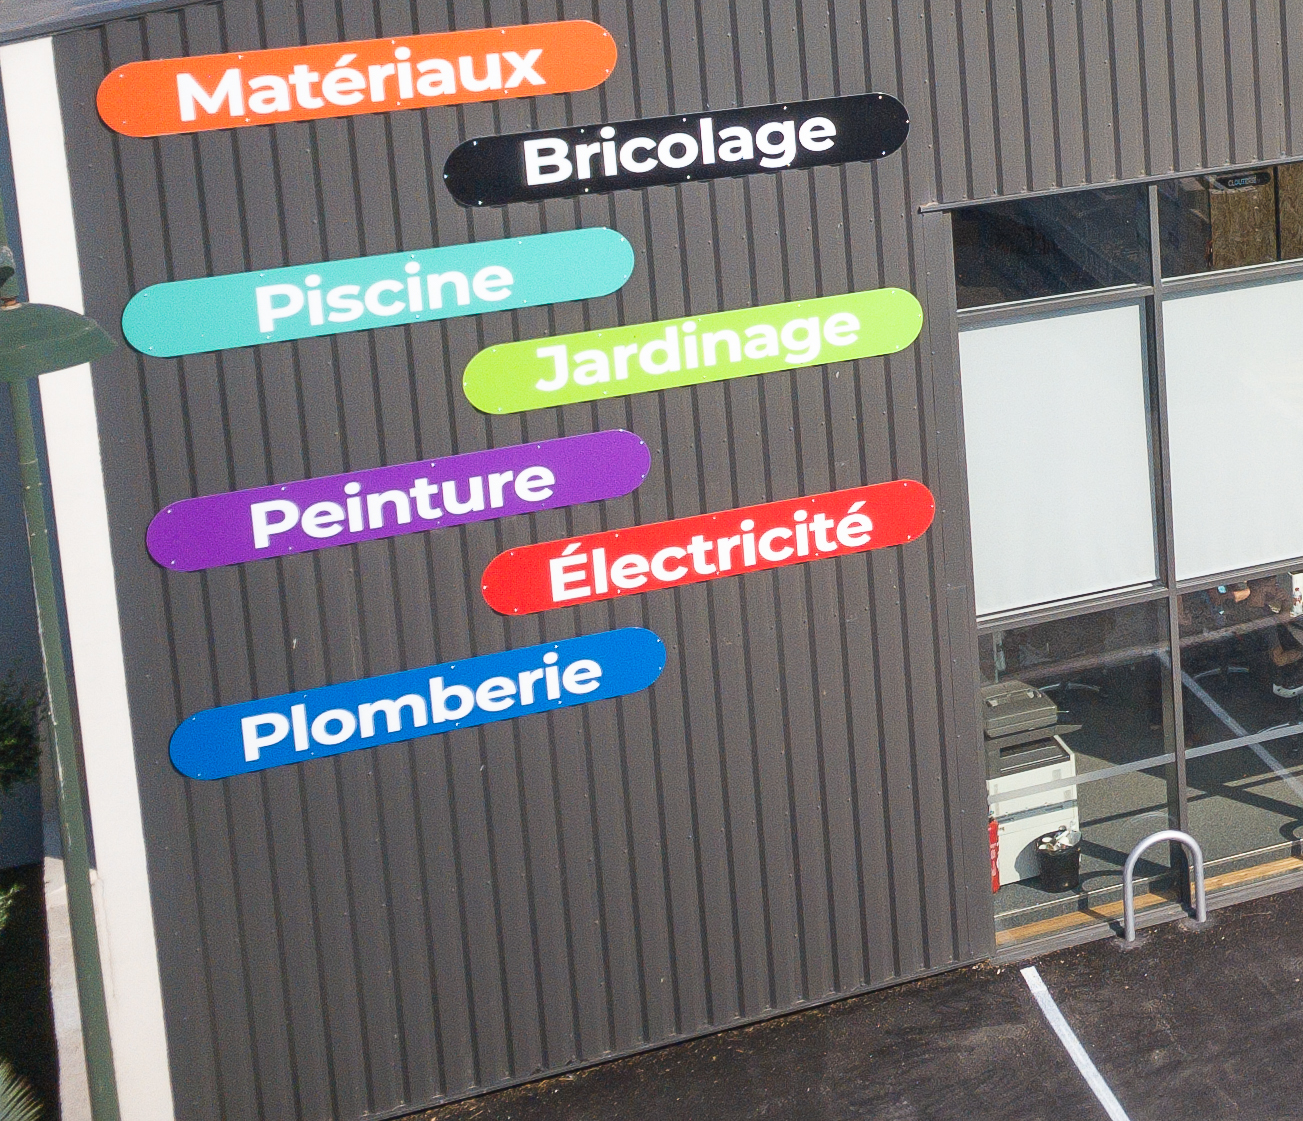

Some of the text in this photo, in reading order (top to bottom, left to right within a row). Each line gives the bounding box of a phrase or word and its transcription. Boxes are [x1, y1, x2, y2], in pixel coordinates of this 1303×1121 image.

[177, 46, 547, 122] Matériaux
[523, 116, 838, 187] Bricolage
[254, 260, 515, 334] Piscine
[534, 311, 862, 393] Jardinage
[250, 462, 556, 550] Peinture
[549, 501, 874, 603] Électricité
[240, 651, 602, 763] Plomberie
